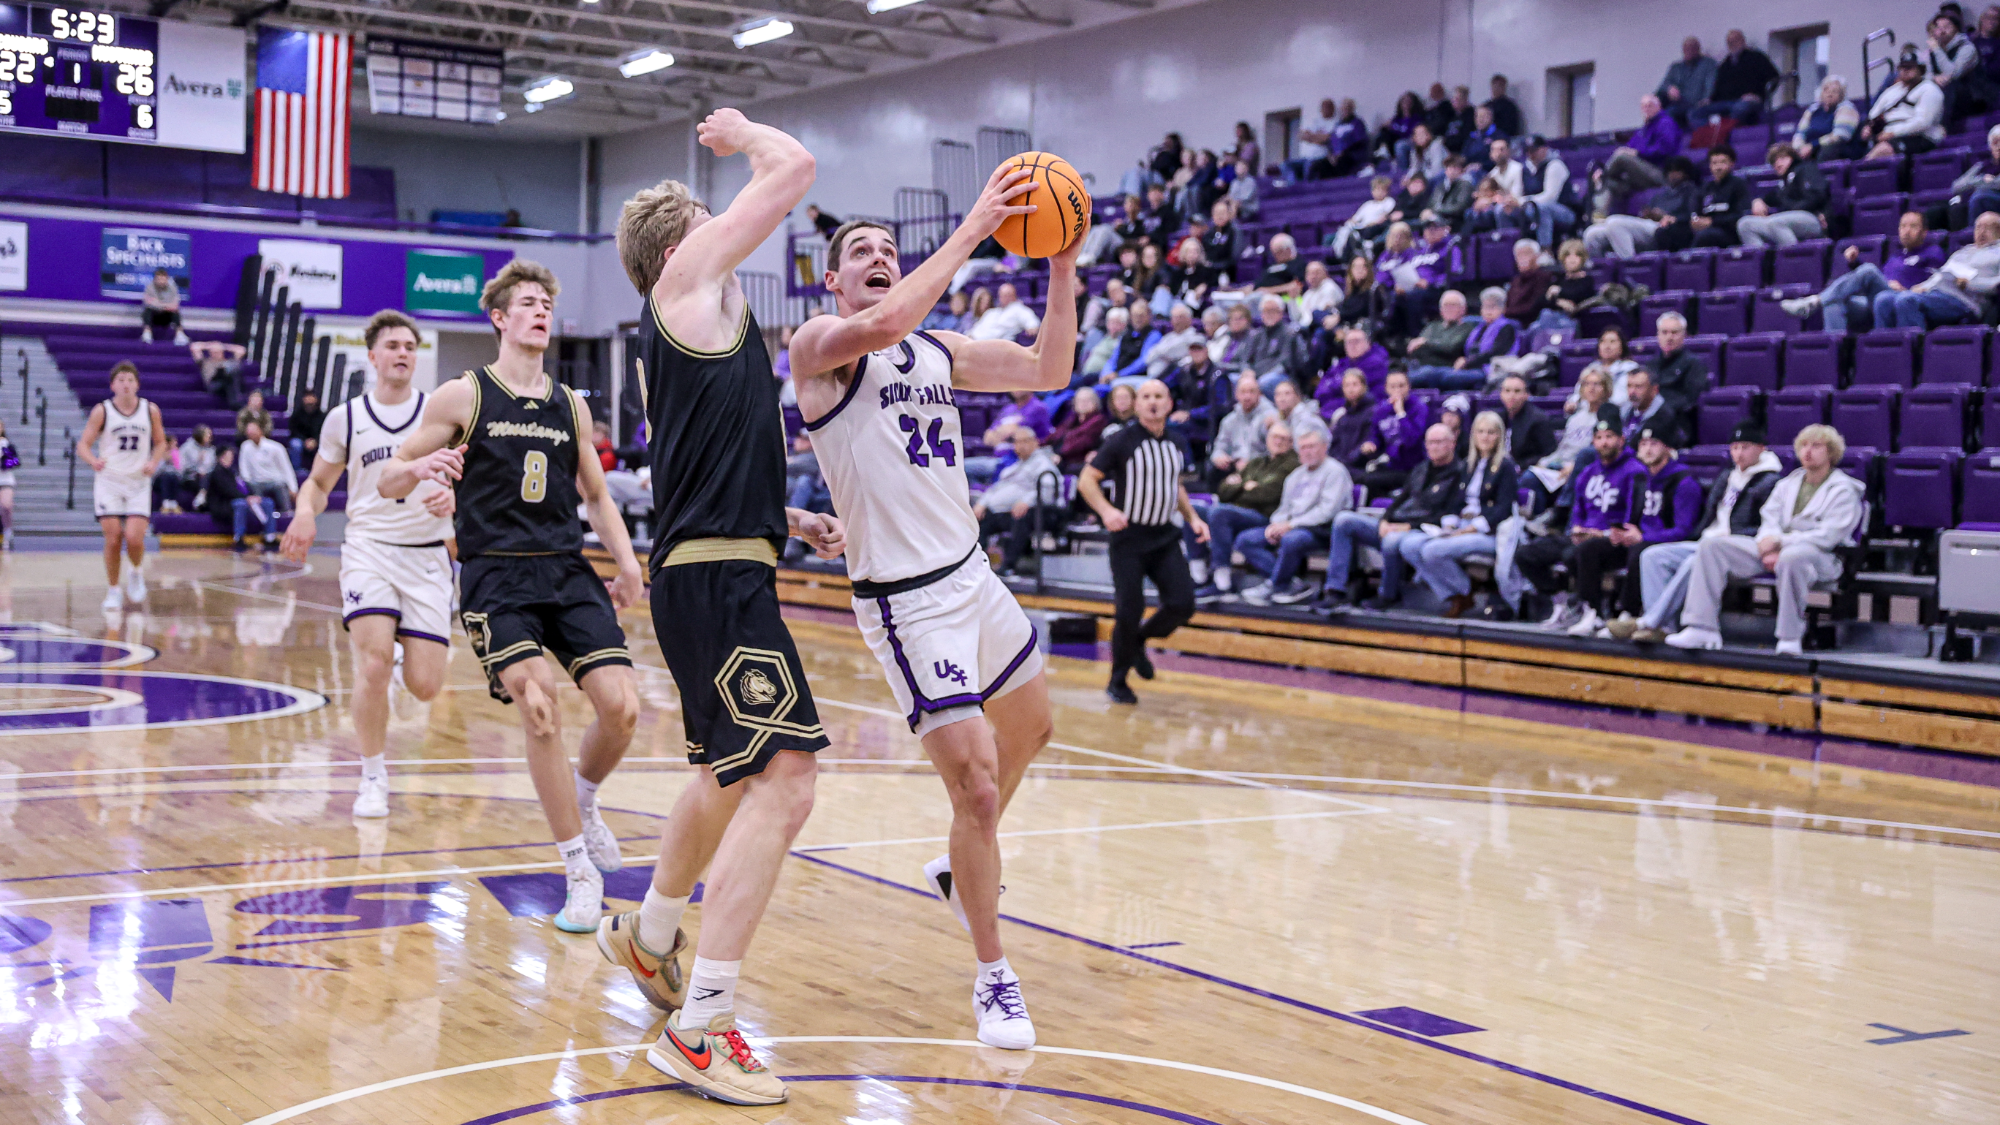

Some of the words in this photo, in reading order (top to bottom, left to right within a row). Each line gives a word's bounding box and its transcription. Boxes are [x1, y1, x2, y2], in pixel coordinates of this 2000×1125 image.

[51, 8, 115, 44] 5:23
[0, 50, 36, 83] 22
[73, 63, 81, 84] 1
[117, 64, 154, 96] 26
[163, 74, 223, 98] Avera
[137, 104, 154, 129] 6
[127, 234, 165, 252] BACK
[413, 272, 462, 293] Avera
[486, 420, 571, 447] Mustangs
[899, 414, 956, 467] 24
[361, 446, 392, 468] SIOUX
[521, 450, 549, 503] 8
[1584, 474, 1620, 513] USF
